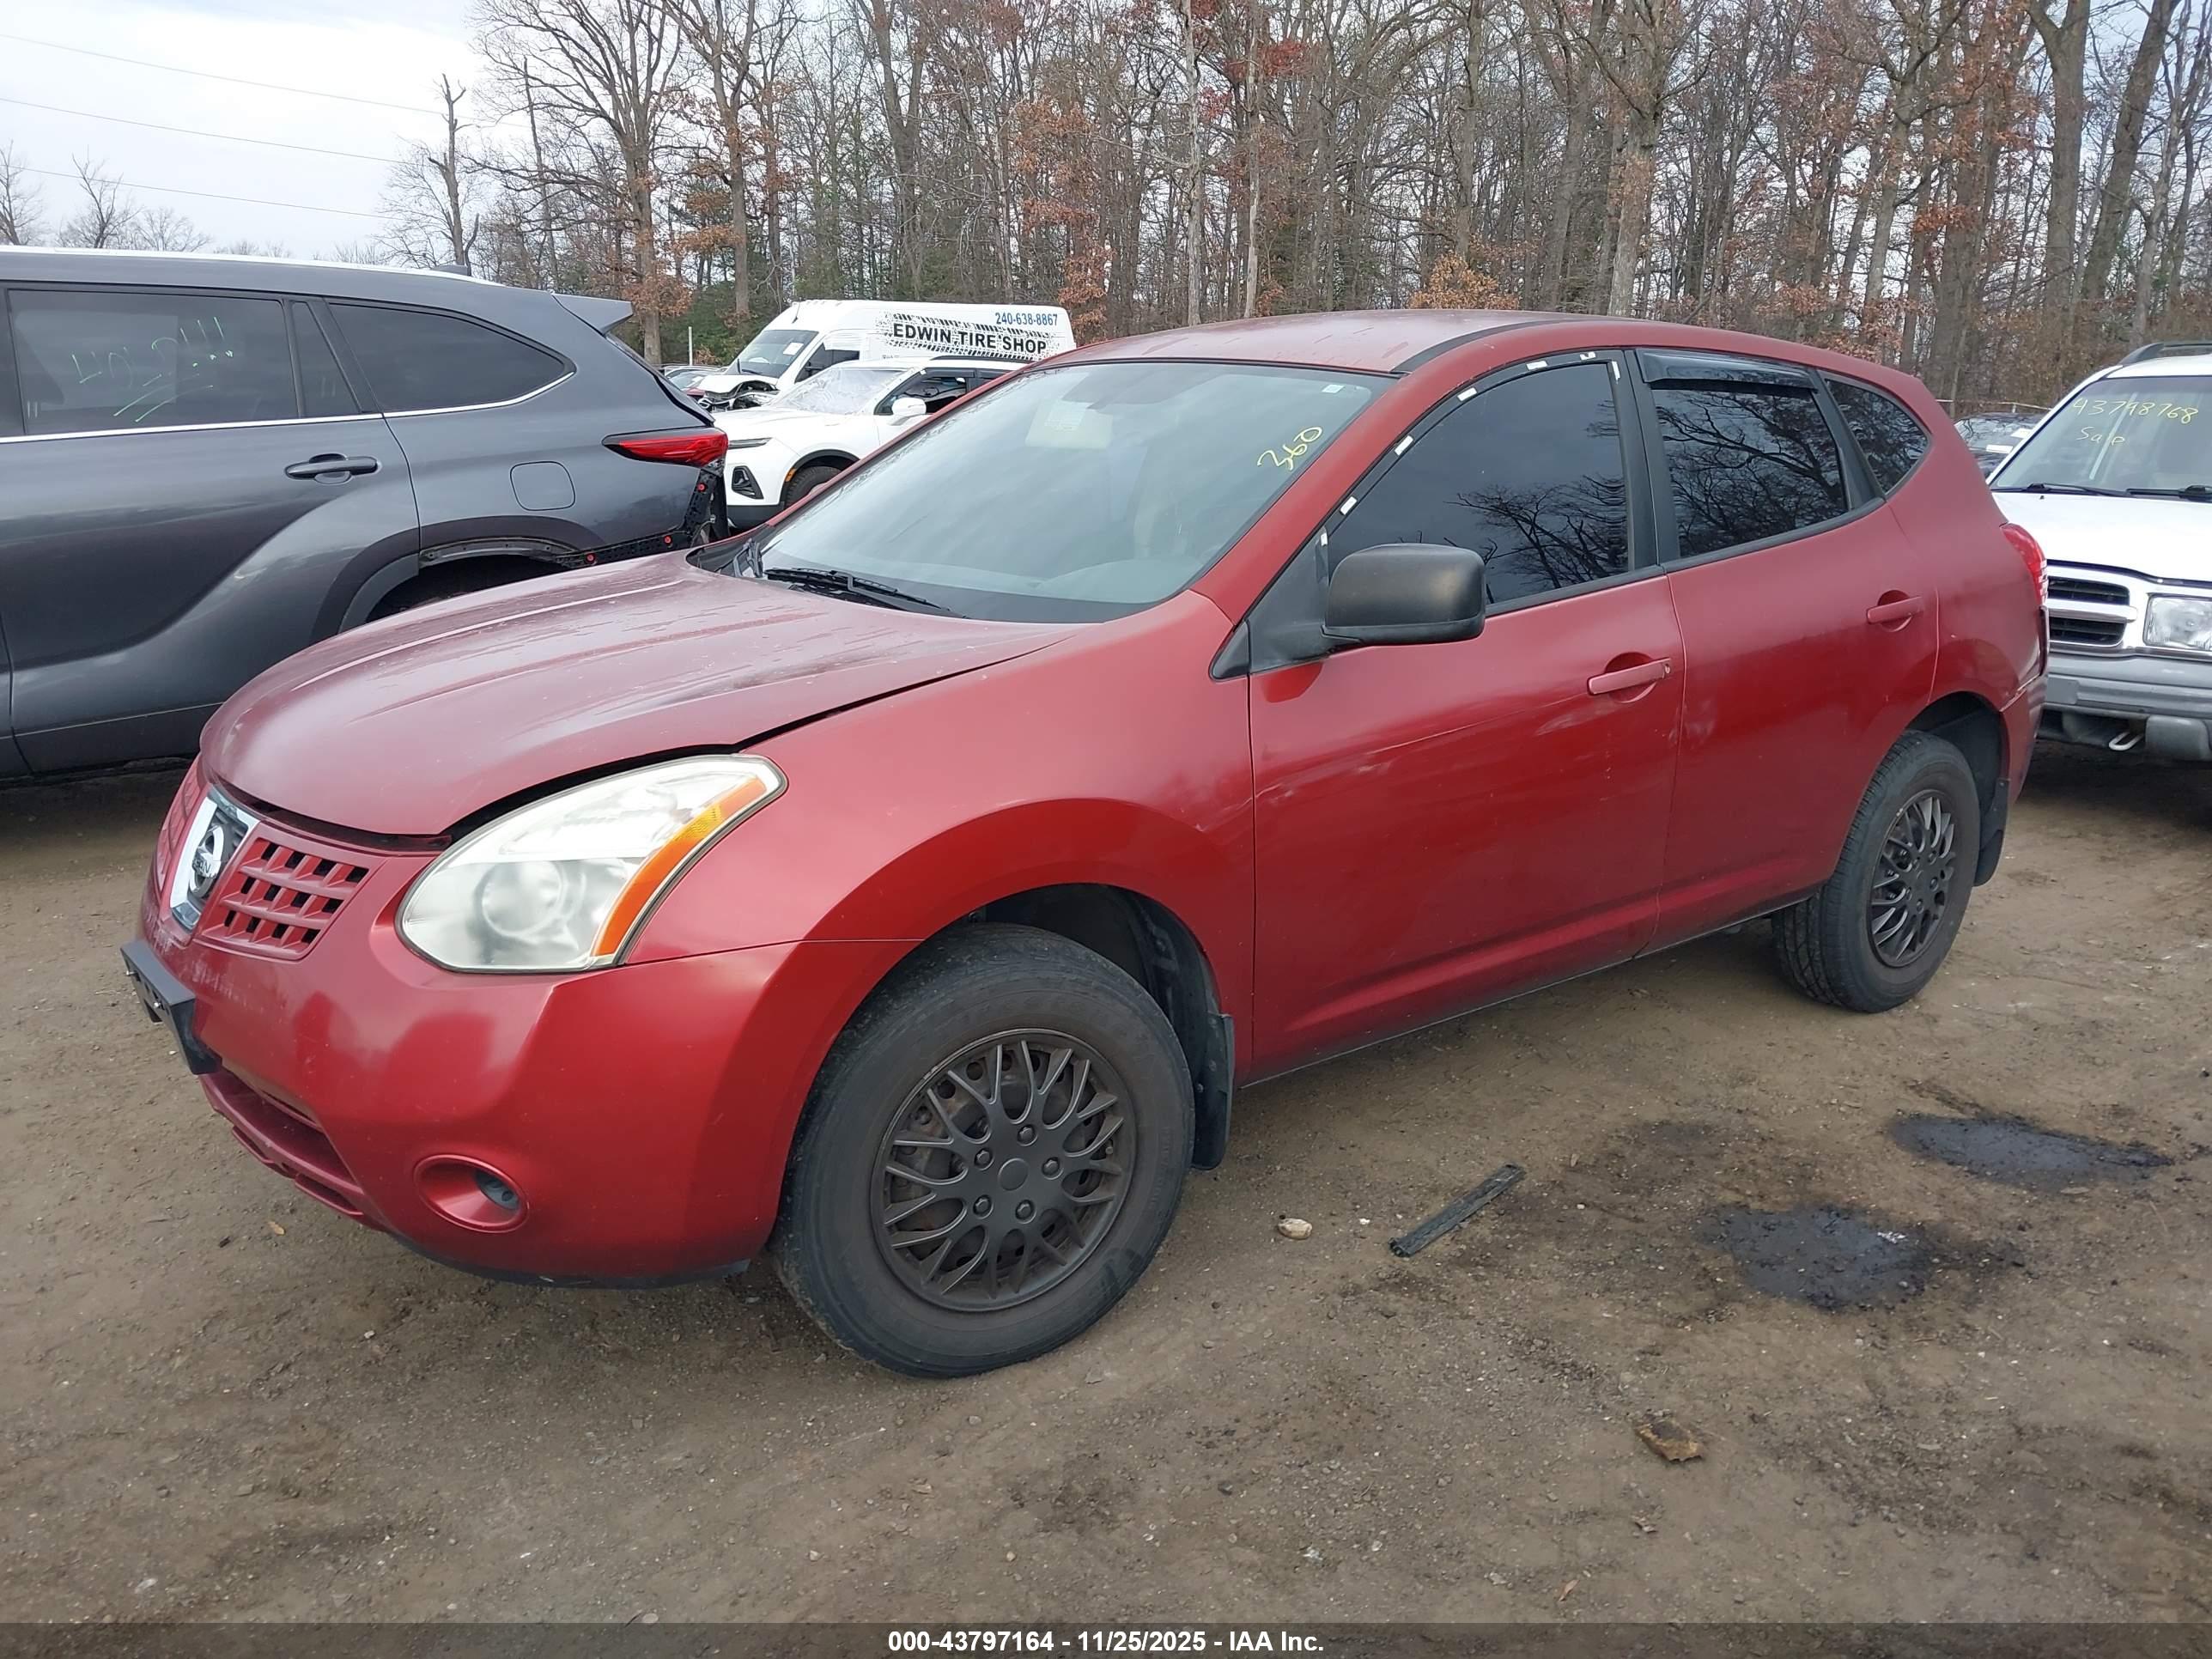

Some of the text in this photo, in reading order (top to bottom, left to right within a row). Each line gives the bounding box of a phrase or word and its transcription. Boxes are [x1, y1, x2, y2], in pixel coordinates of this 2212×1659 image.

[995, 312, 1058, 326] 240-638-8867
[893, 323, 1047, 355] EDWIN TIRE SHOP
